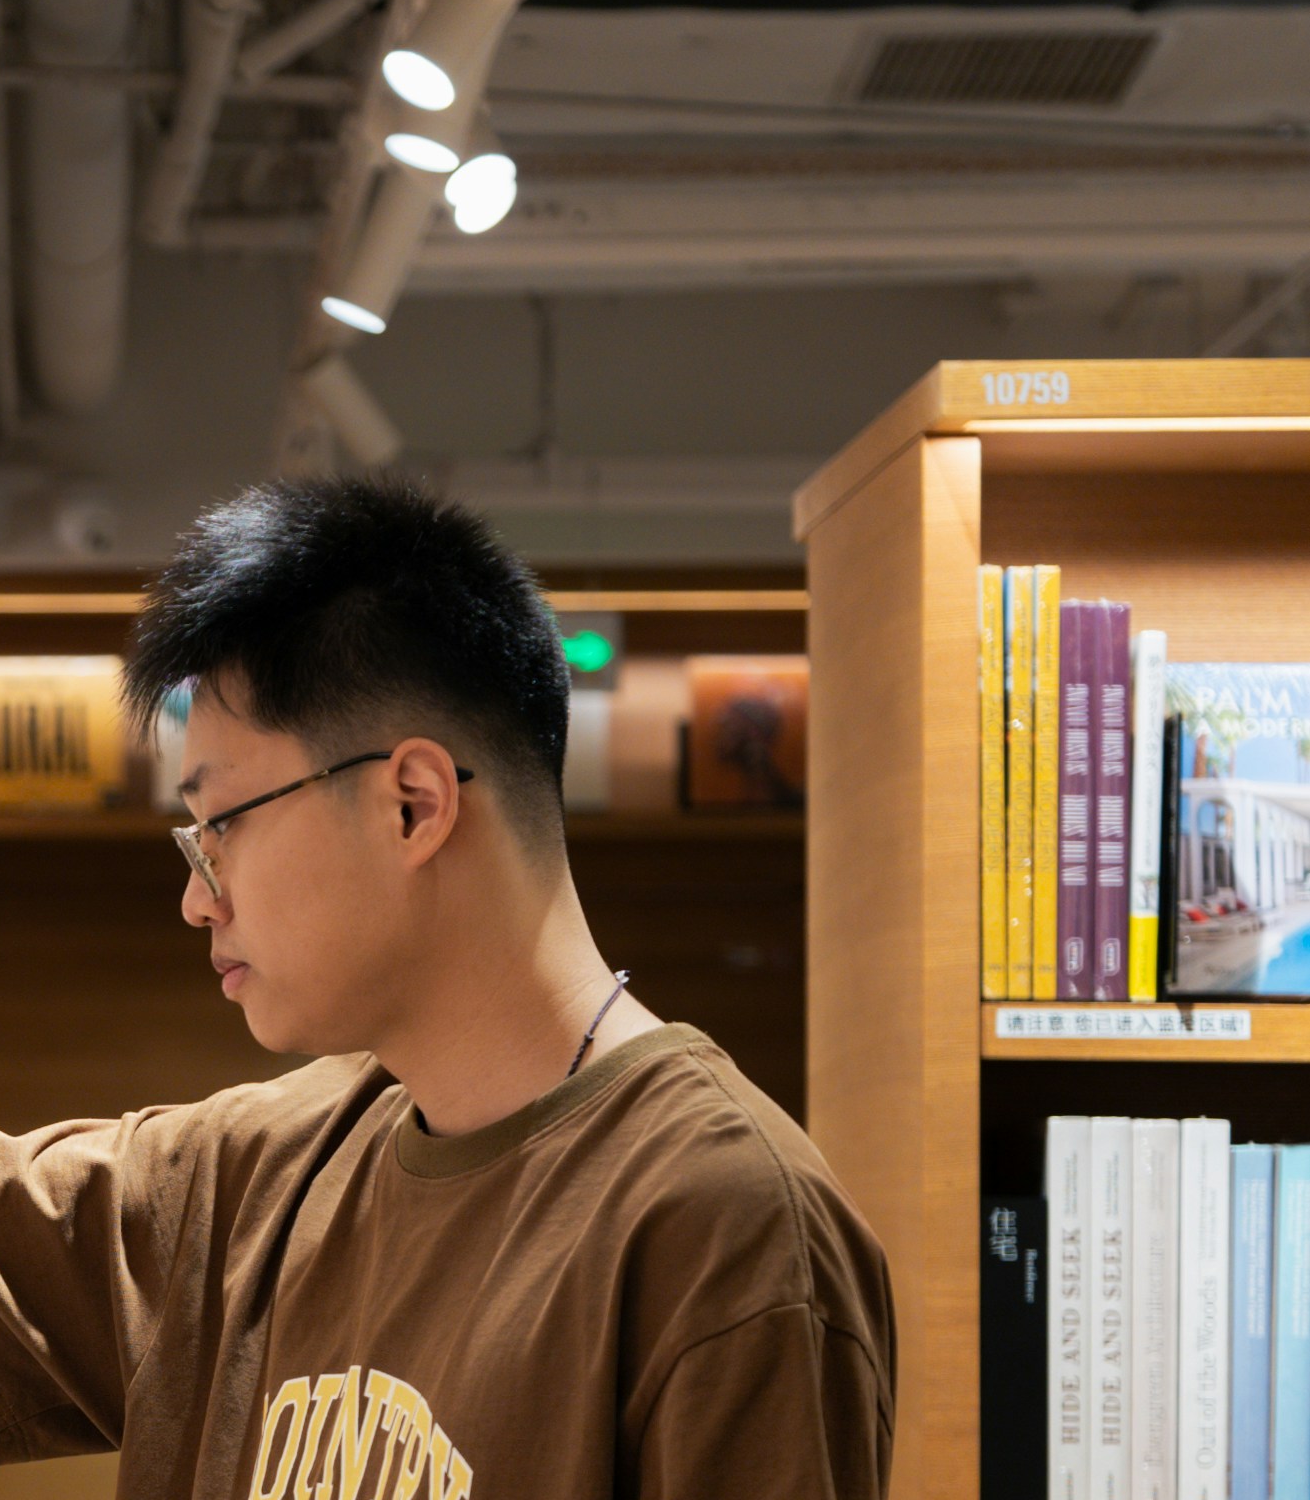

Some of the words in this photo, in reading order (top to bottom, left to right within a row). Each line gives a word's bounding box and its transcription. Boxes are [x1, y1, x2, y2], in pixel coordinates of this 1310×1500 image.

[981, 371, 1070, 405] 10759
[1194, 686, 1292, 717] PALM
[1060, 1227, 1080, 1300] SEEK
[1101, 1228, 1122, 1301] SEEK
[1060, 1307, 1080, 1366] AND
[1101, 1308, 1122, 1366] AND
[1196, 1275, 1217, 1351] Woods
[1196, 1355, 1217, 1391] the
[1060, 1376, 1080, 1445] HIDE
[1101, 1376, 1122, 1446] HIDE
[1196, 1395, 1217, 1420] of
[1196, 1424, 1218, 1470] Out
